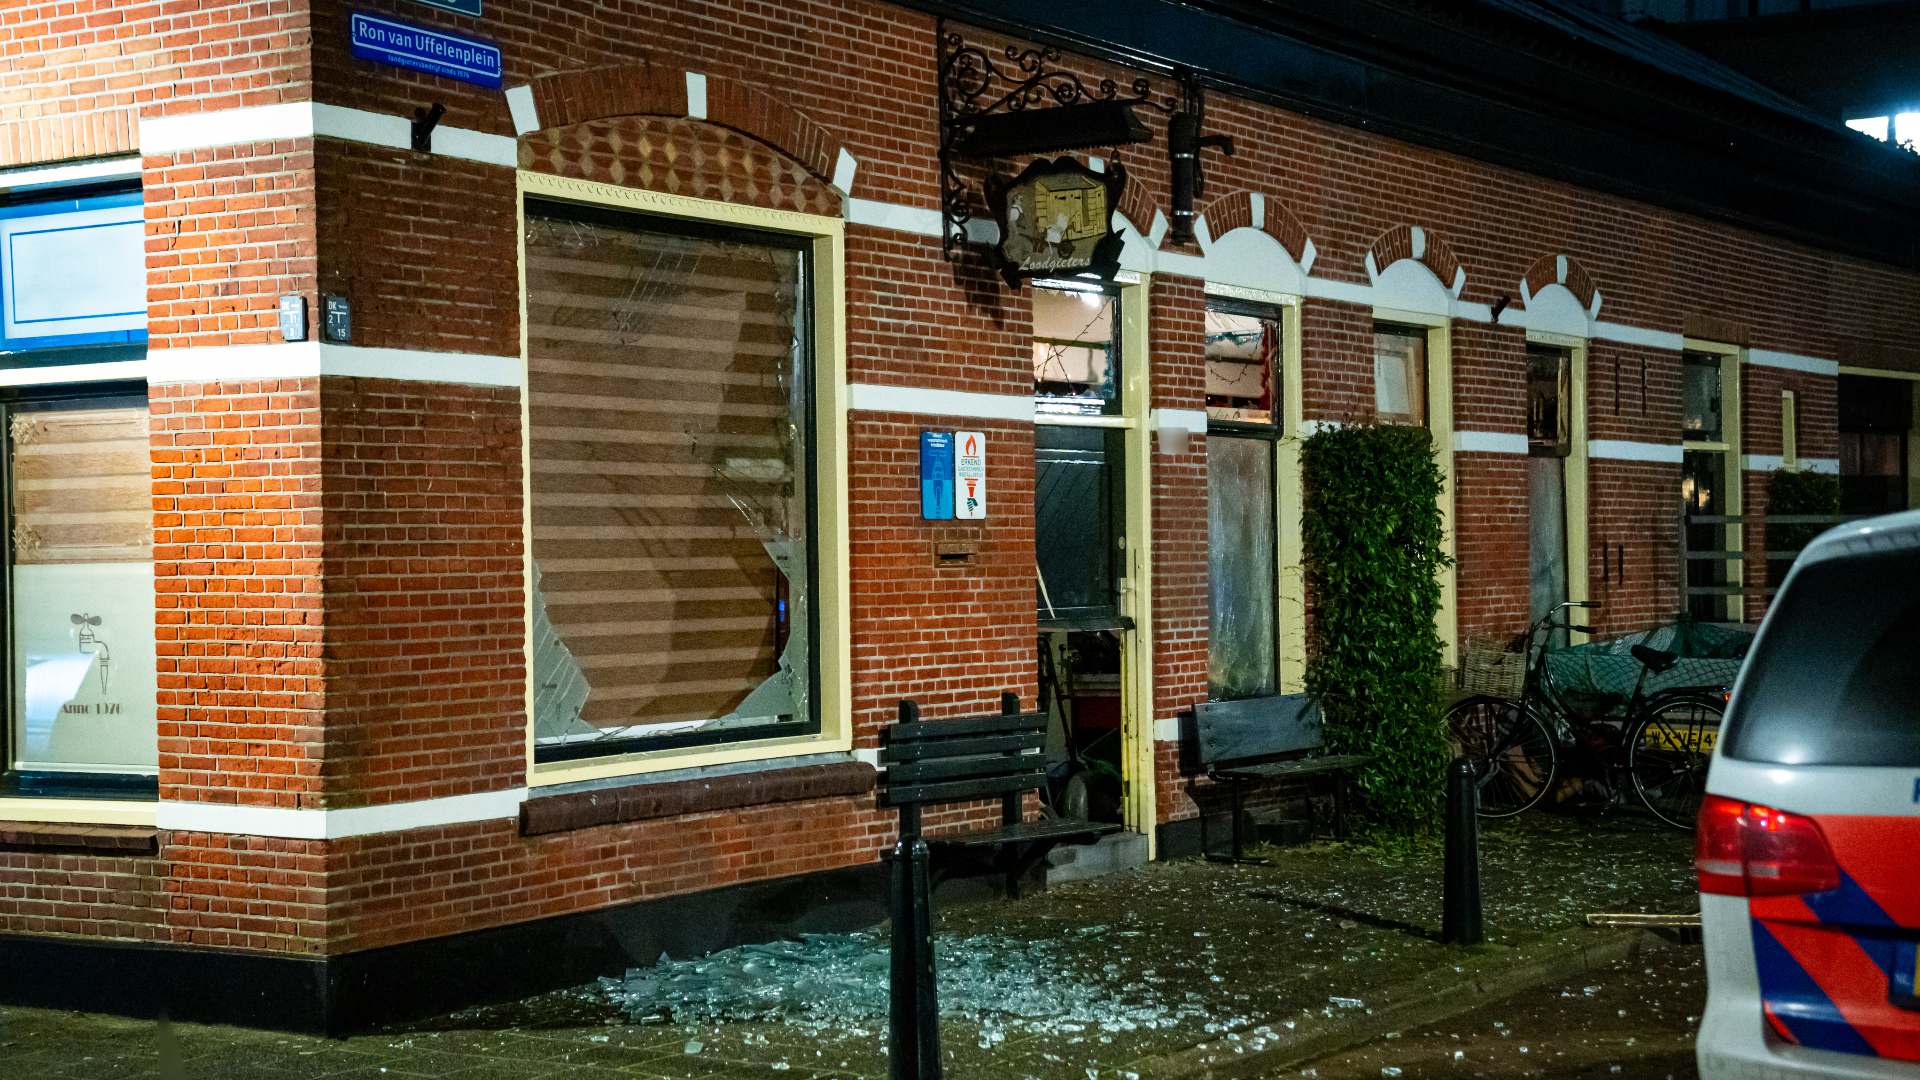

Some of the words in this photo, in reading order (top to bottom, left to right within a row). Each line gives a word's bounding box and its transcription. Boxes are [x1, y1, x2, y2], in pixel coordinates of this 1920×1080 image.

[359, 21, 385, 42] Ron
[388, 31, 412, 48] van
[415, 34, 495, 68] Uffelenplein
[1018, 256, 1091, 273] Loodgieters
[281, 301, 290, 310] DK
[328, 301, 337, 310] DK
[328, 315, 333, 323] 2
[337, 328, 346, 337] 15
[960, 458, 982, 466] ERKEND
[60, 703, 92, 714] Anno
[96, 702, 124, 715] 1976
